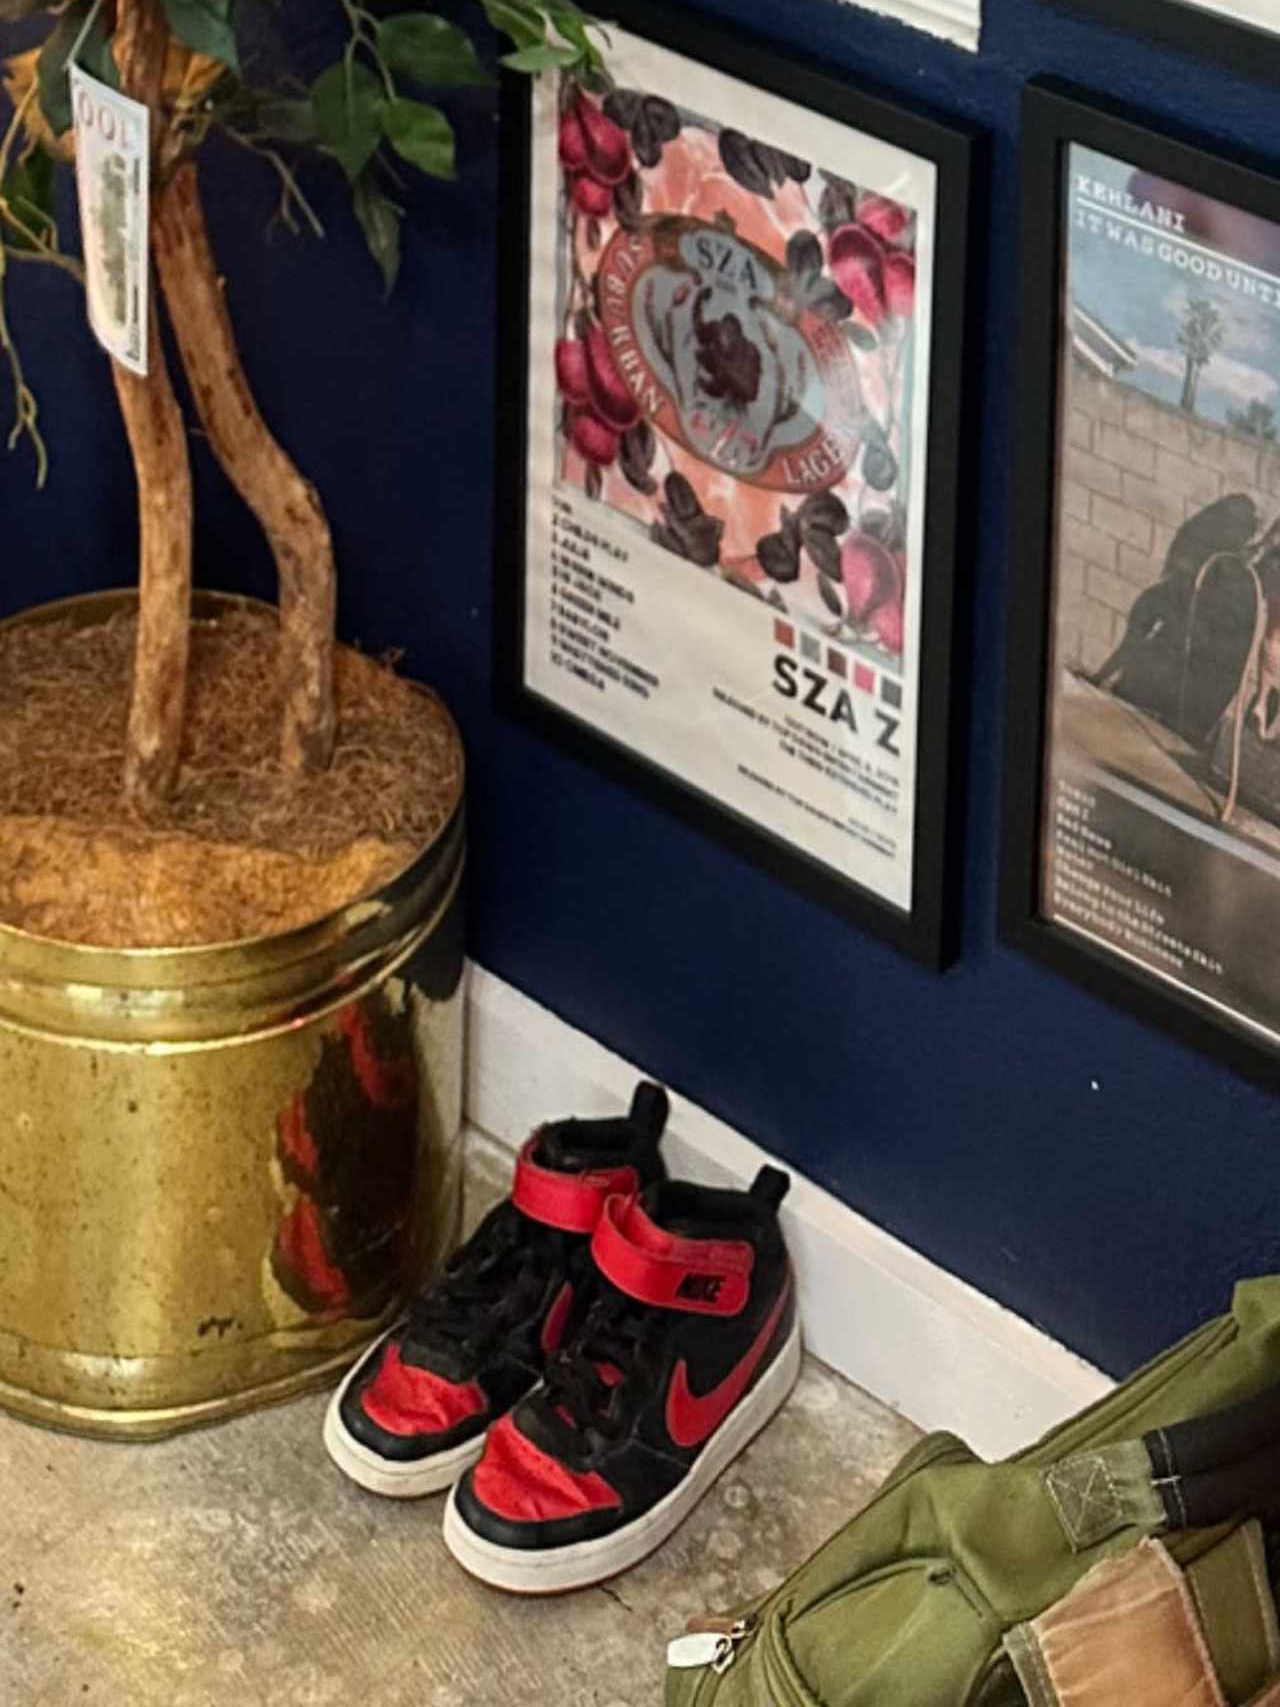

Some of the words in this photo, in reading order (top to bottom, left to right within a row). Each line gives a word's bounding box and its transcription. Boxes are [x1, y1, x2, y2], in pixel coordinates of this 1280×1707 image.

[1076, 176, 1185, 232] KEHLANI
[695, 238, 757, 291] SZA
[1106, 222, 1151, 255] WAS
[1158, 243, 1222, 282] GOOD
[771, 653, 857, 732] SZA
[675, 1274, 727, 1303] NIKE
